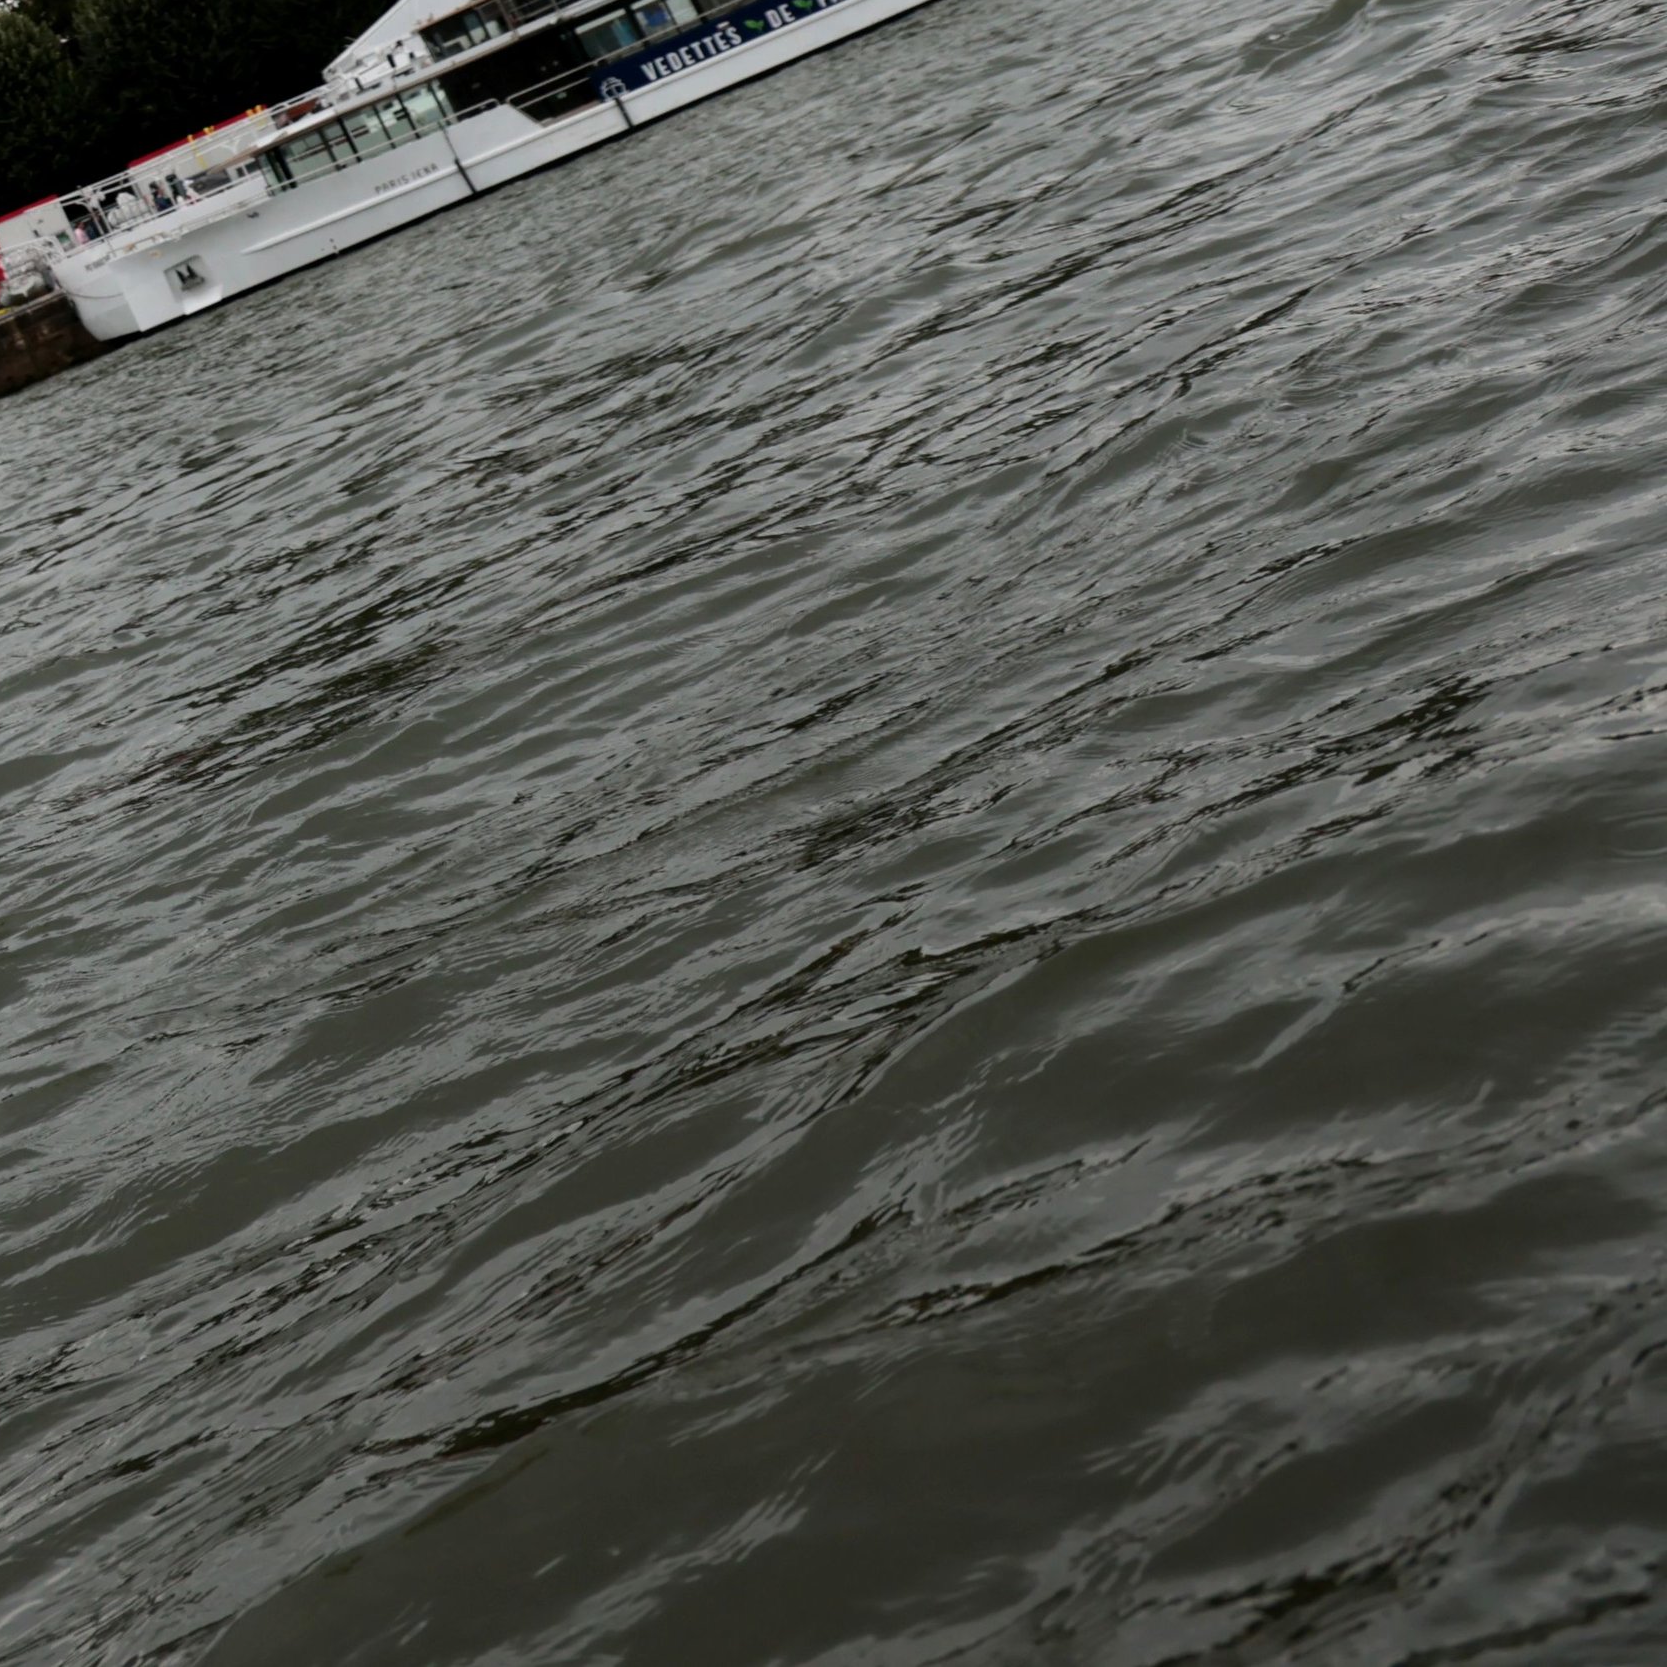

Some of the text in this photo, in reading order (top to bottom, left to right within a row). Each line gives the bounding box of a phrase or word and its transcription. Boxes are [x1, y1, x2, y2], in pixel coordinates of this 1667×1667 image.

[641, 25, 742, 81] VEDETTES
[764, 4, 796, 30] DE
[375, 174, 410, 194] PARIS
